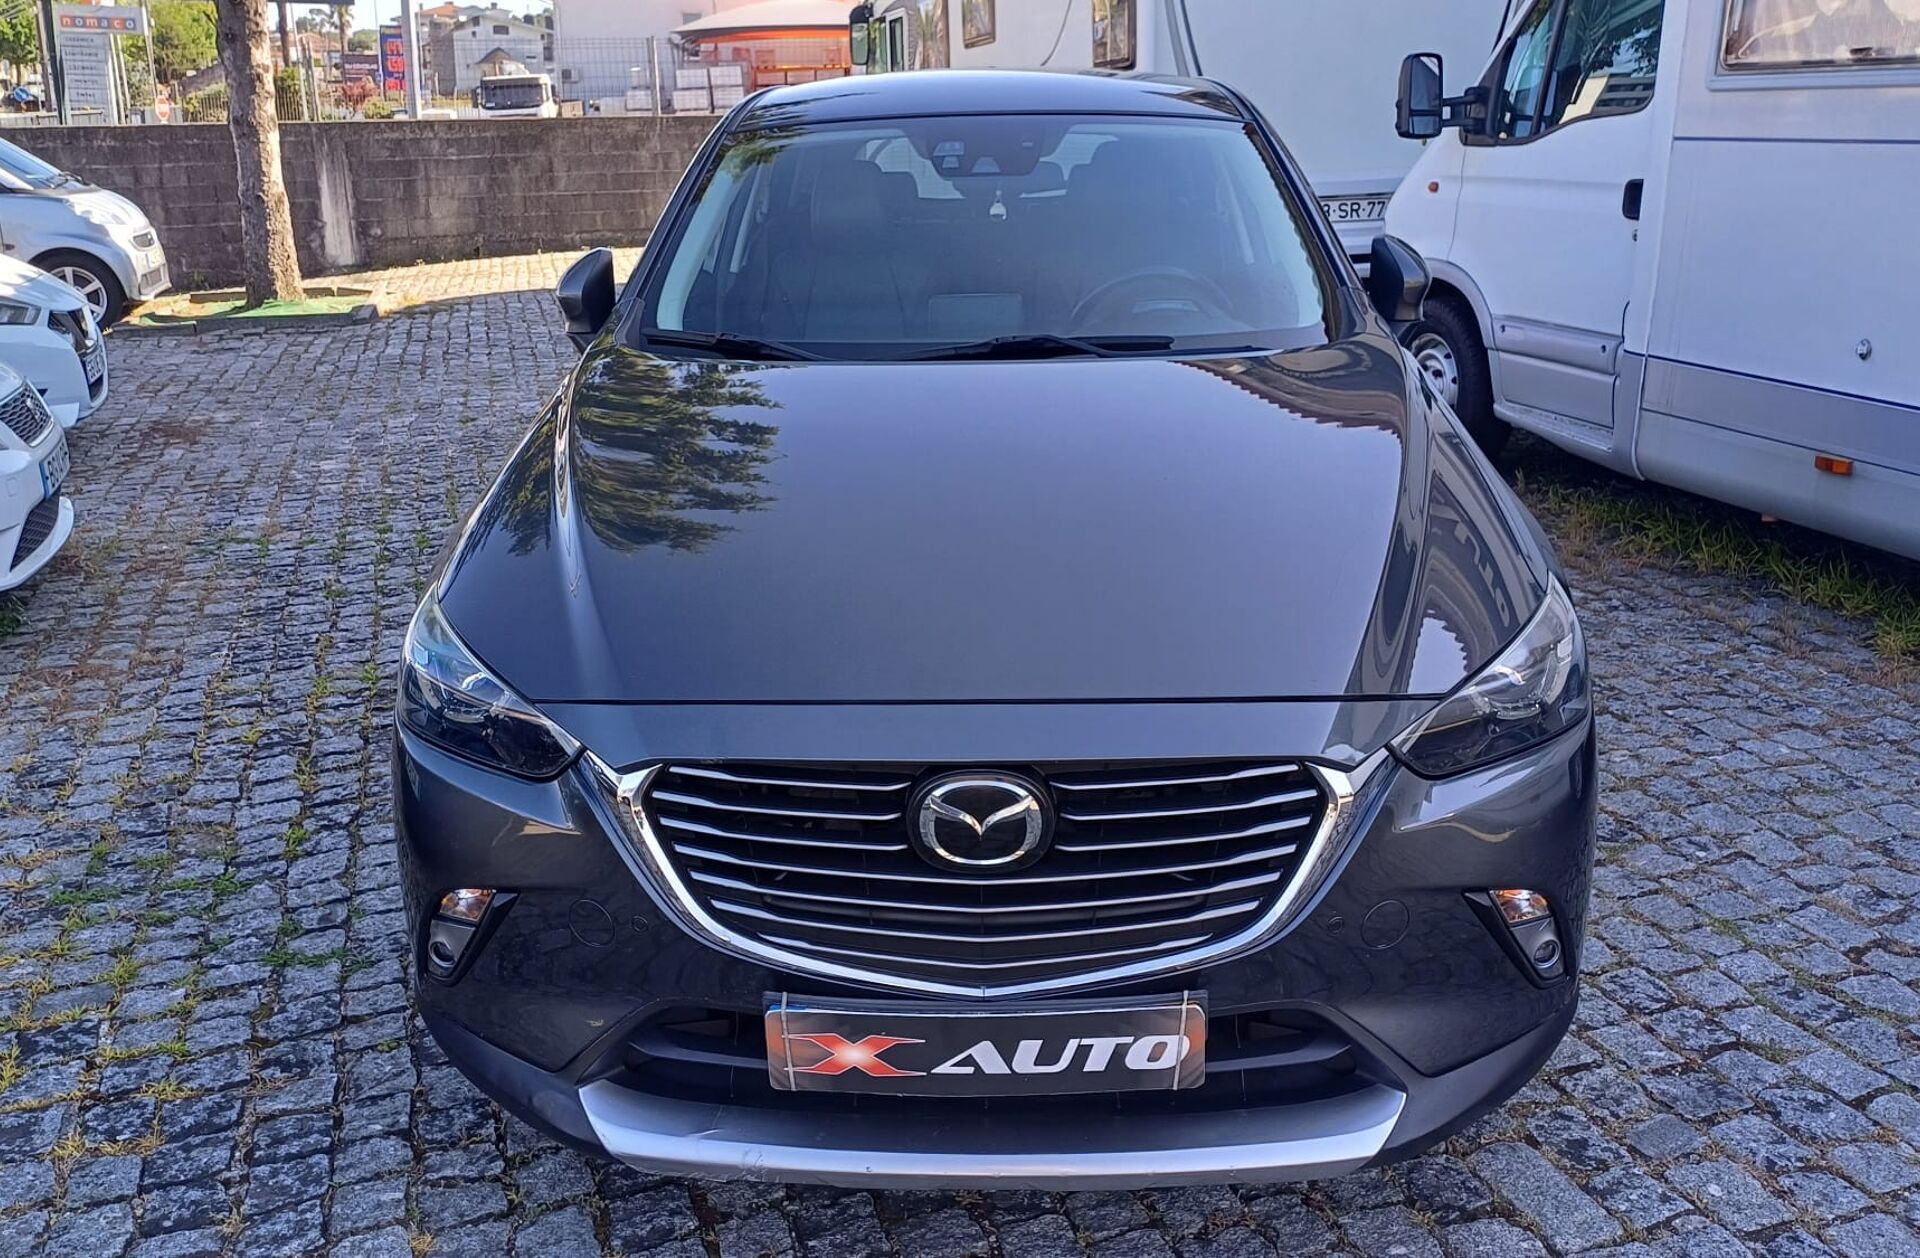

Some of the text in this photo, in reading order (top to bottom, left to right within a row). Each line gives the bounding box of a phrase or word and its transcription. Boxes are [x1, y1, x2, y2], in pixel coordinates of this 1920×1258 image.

[61, 17, 135, 29] nomaco
[782, 1033, 1191, 1077] X AUTO
